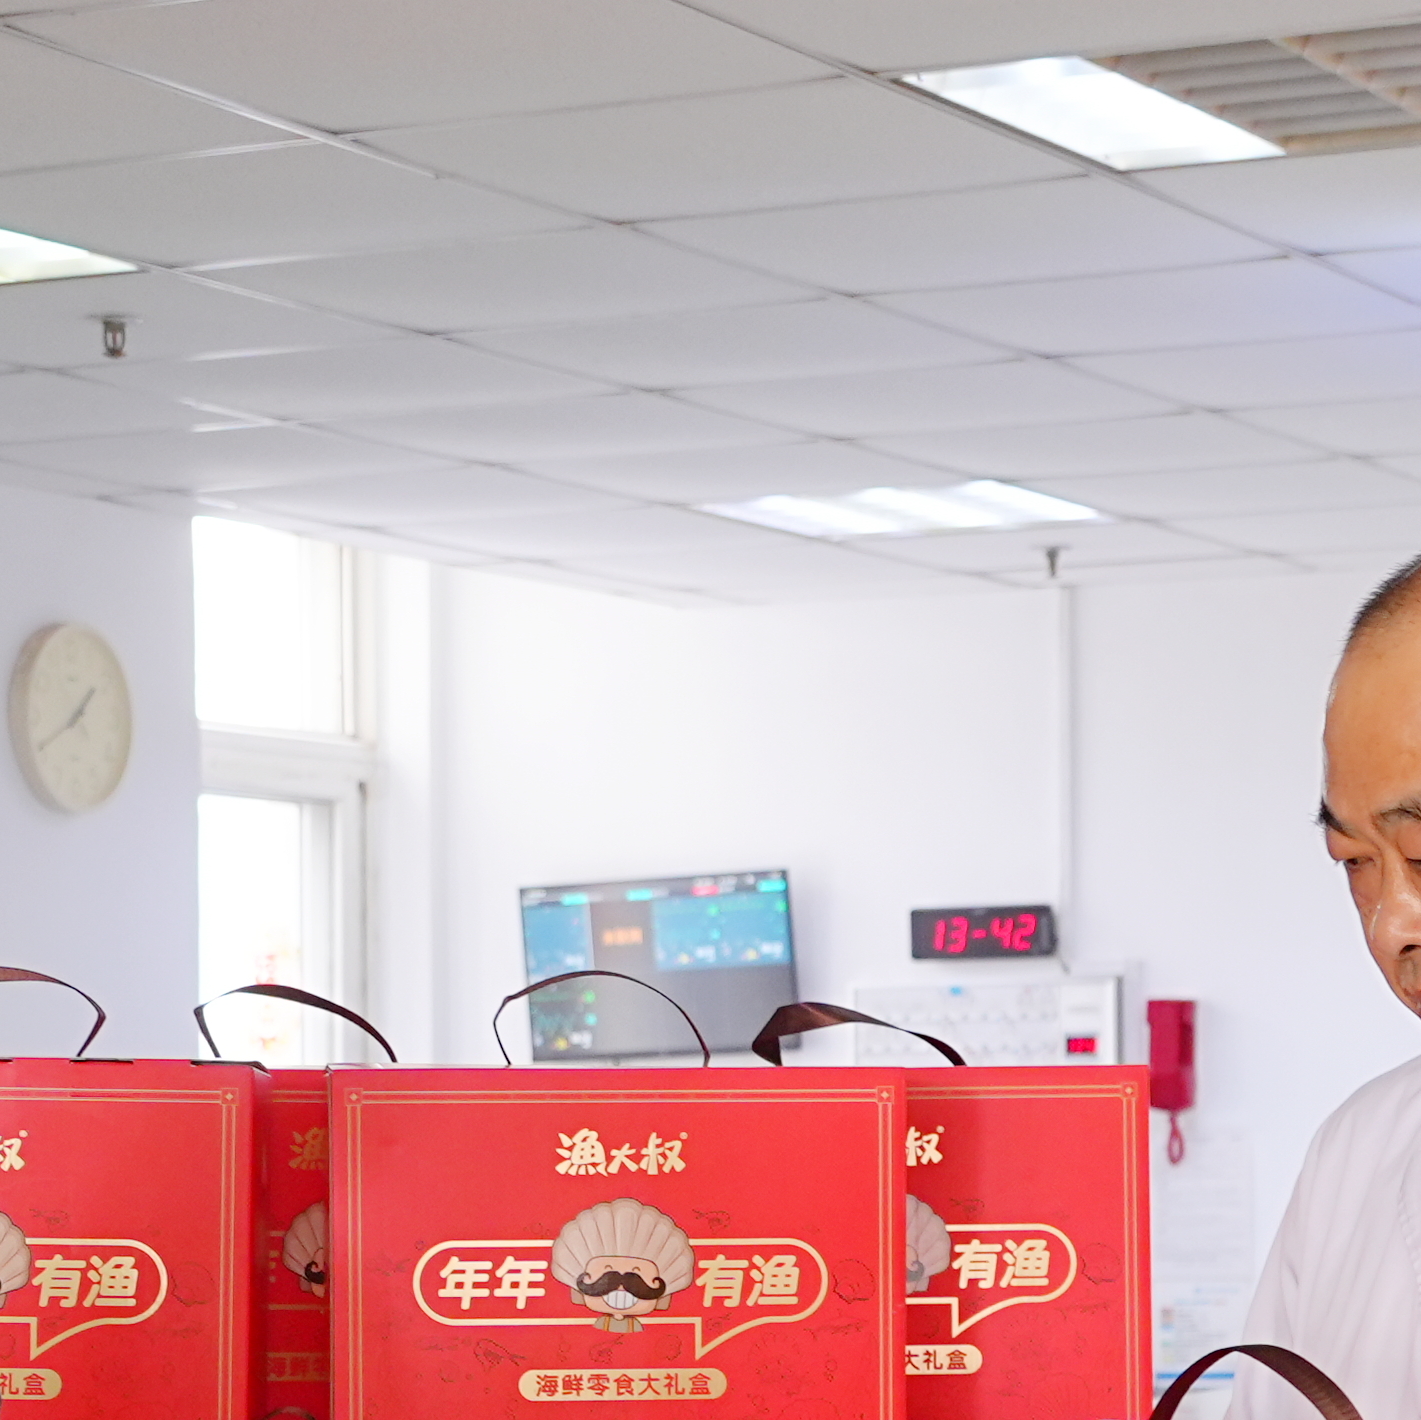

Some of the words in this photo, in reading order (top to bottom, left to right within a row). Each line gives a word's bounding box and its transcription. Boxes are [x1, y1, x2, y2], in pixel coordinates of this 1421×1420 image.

[31, 1253, 139, 1308] 有渔
[438, 1255, 549, 1311] 年年
[694, 1253, 801, 1308] 有渔
[951, 1238, 1051, 1289] 有渔
[535, 1373, 712, 1397] 海鲜零食大礼盒
